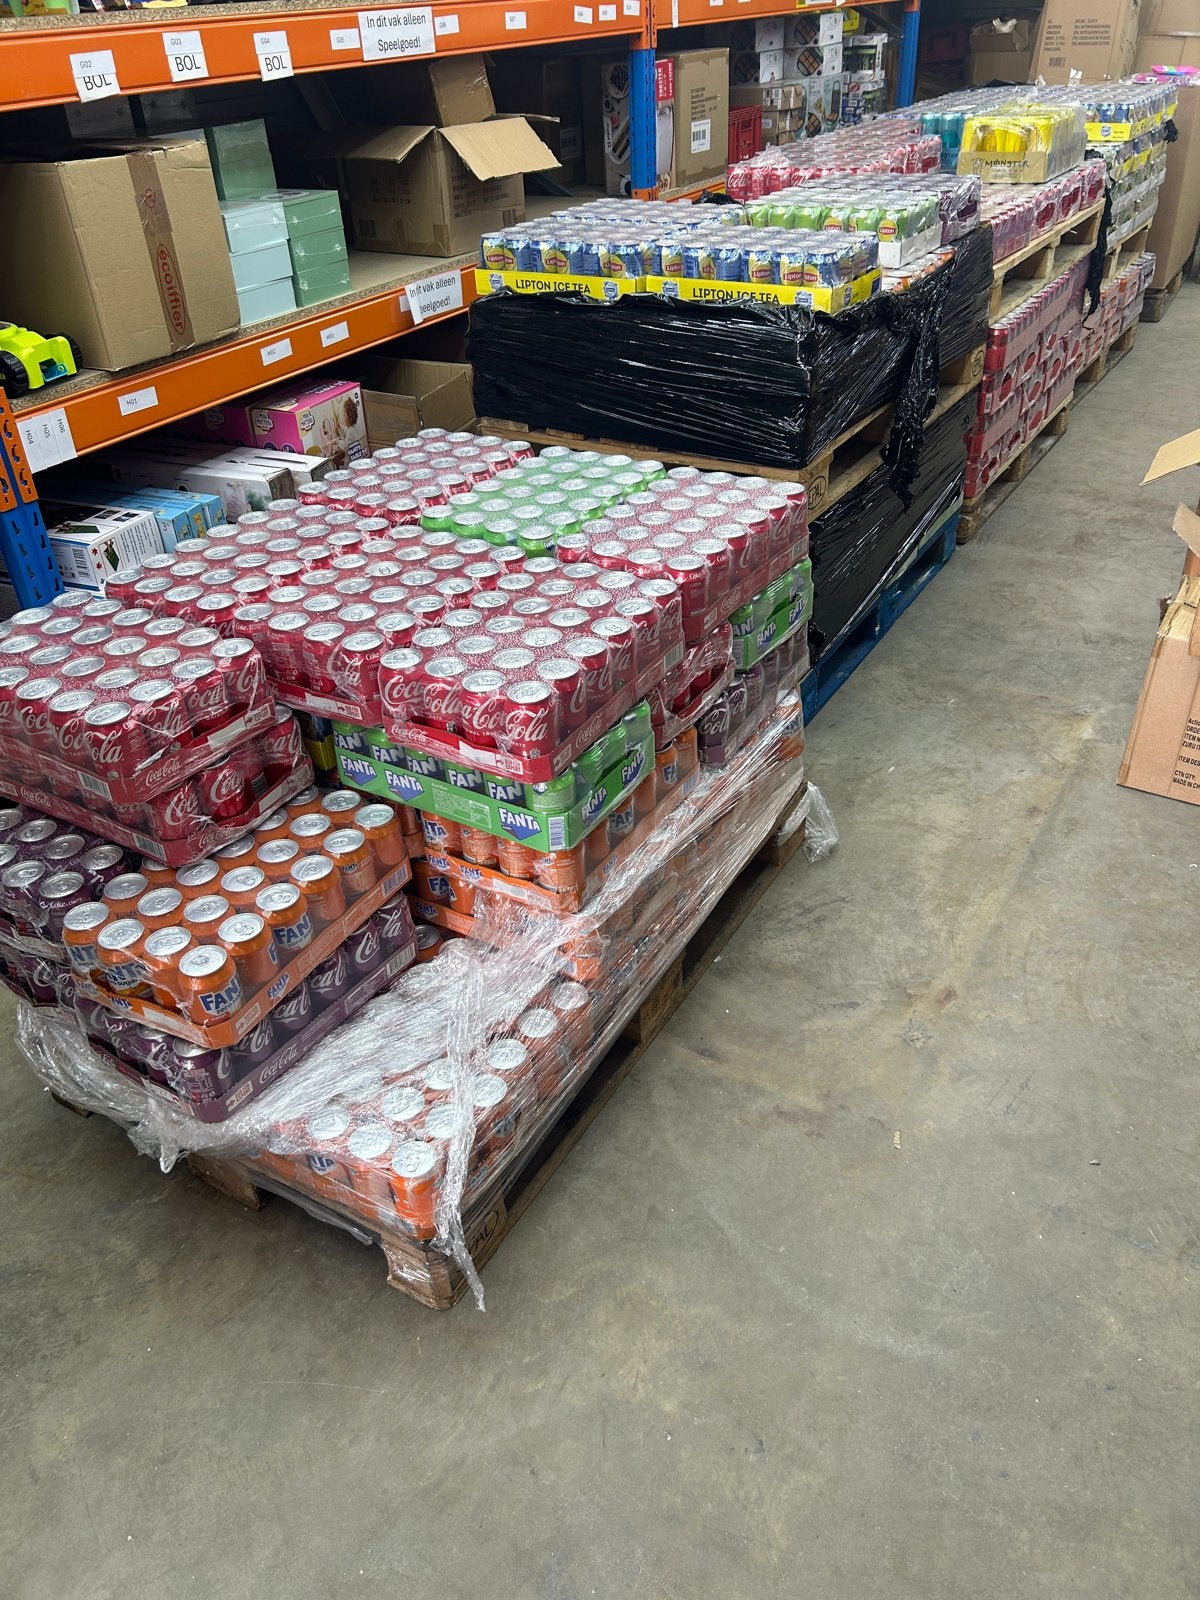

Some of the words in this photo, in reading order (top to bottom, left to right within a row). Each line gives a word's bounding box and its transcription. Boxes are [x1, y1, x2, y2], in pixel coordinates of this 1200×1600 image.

[366, 15, 375, 29] In
[376, 14, 388, 28] dit
[388, 14, 402, 27] vak
[402, 12, 427, 26] alleen
[170, 38, 182, 46] G03
[260, 36, 271, 45] G04
[377, 36, 422, 53] Speelgoed!
[80, 60, 92, 69] G02
[174, 54, 202, 72] BOL
[264, 54, 288, 72] BOL
[83, 73, 112, 91] BOL
[158, 249, 184, 330] ecoiffier
[422, 279, 435, 293] vak
[434, 275, 456, 290] alleen
[515, 279, 551, 291] LIPTON
[573, 282, 591, 294] TEA
[692, 287, 735, 300] LIPTON
[758, 292, 780, 304] TEA
[126, 398, 138, 406] H01
[41, 423, 51, 439] H05
[57, 418, 66, 434] H06
[25, 429, 35, 445] H04
[1182, 740, 1196, 750] ZURU
[1184, 733, 1197, 741] ITEM
[340, 754, 376, 776] FANTA
[1178, 755, 1190, 764] ITEM
[145, 758, 181, 787] Coca-Cola
[384, 769, 424, 792] FANTA
[1174, 769, 1185, 778] CTN
[1185, 772, 1197, 780] QTY:
[1172, 776, 1187, 786] MADE
[498, 808, 541, 831] FANTA
[267, 972, 290, 998] FANTA
[216, 1001, 232, 1015] zero
[259, 1045, 299, 1085] Coca-Cola
